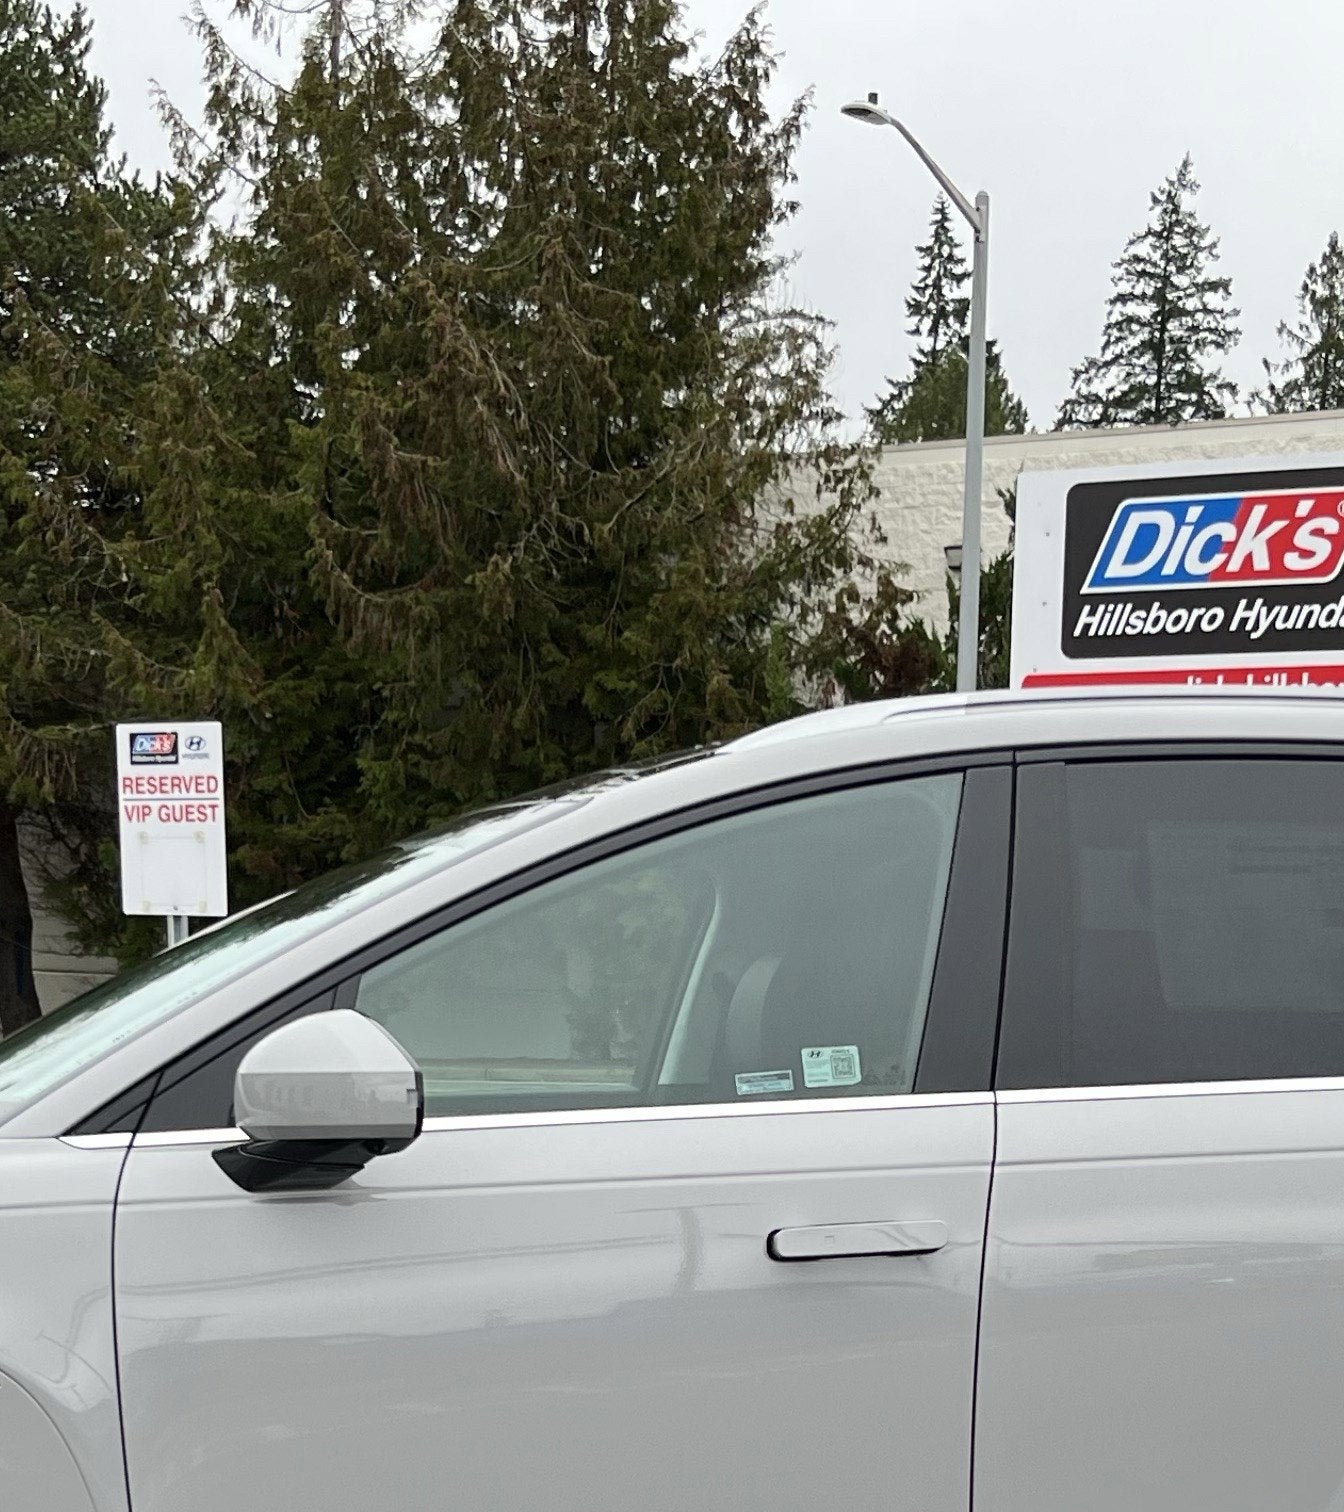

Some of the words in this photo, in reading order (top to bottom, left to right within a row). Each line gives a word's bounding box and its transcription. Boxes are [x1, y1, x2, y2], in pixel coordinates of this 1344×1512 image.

[1072, 602, 1225, 637] Hillsboro
[122, 775, 219, 795] RESERVED
[124, 804, 152, 823] VIP
[158, 804, 220, 823] GUEST
